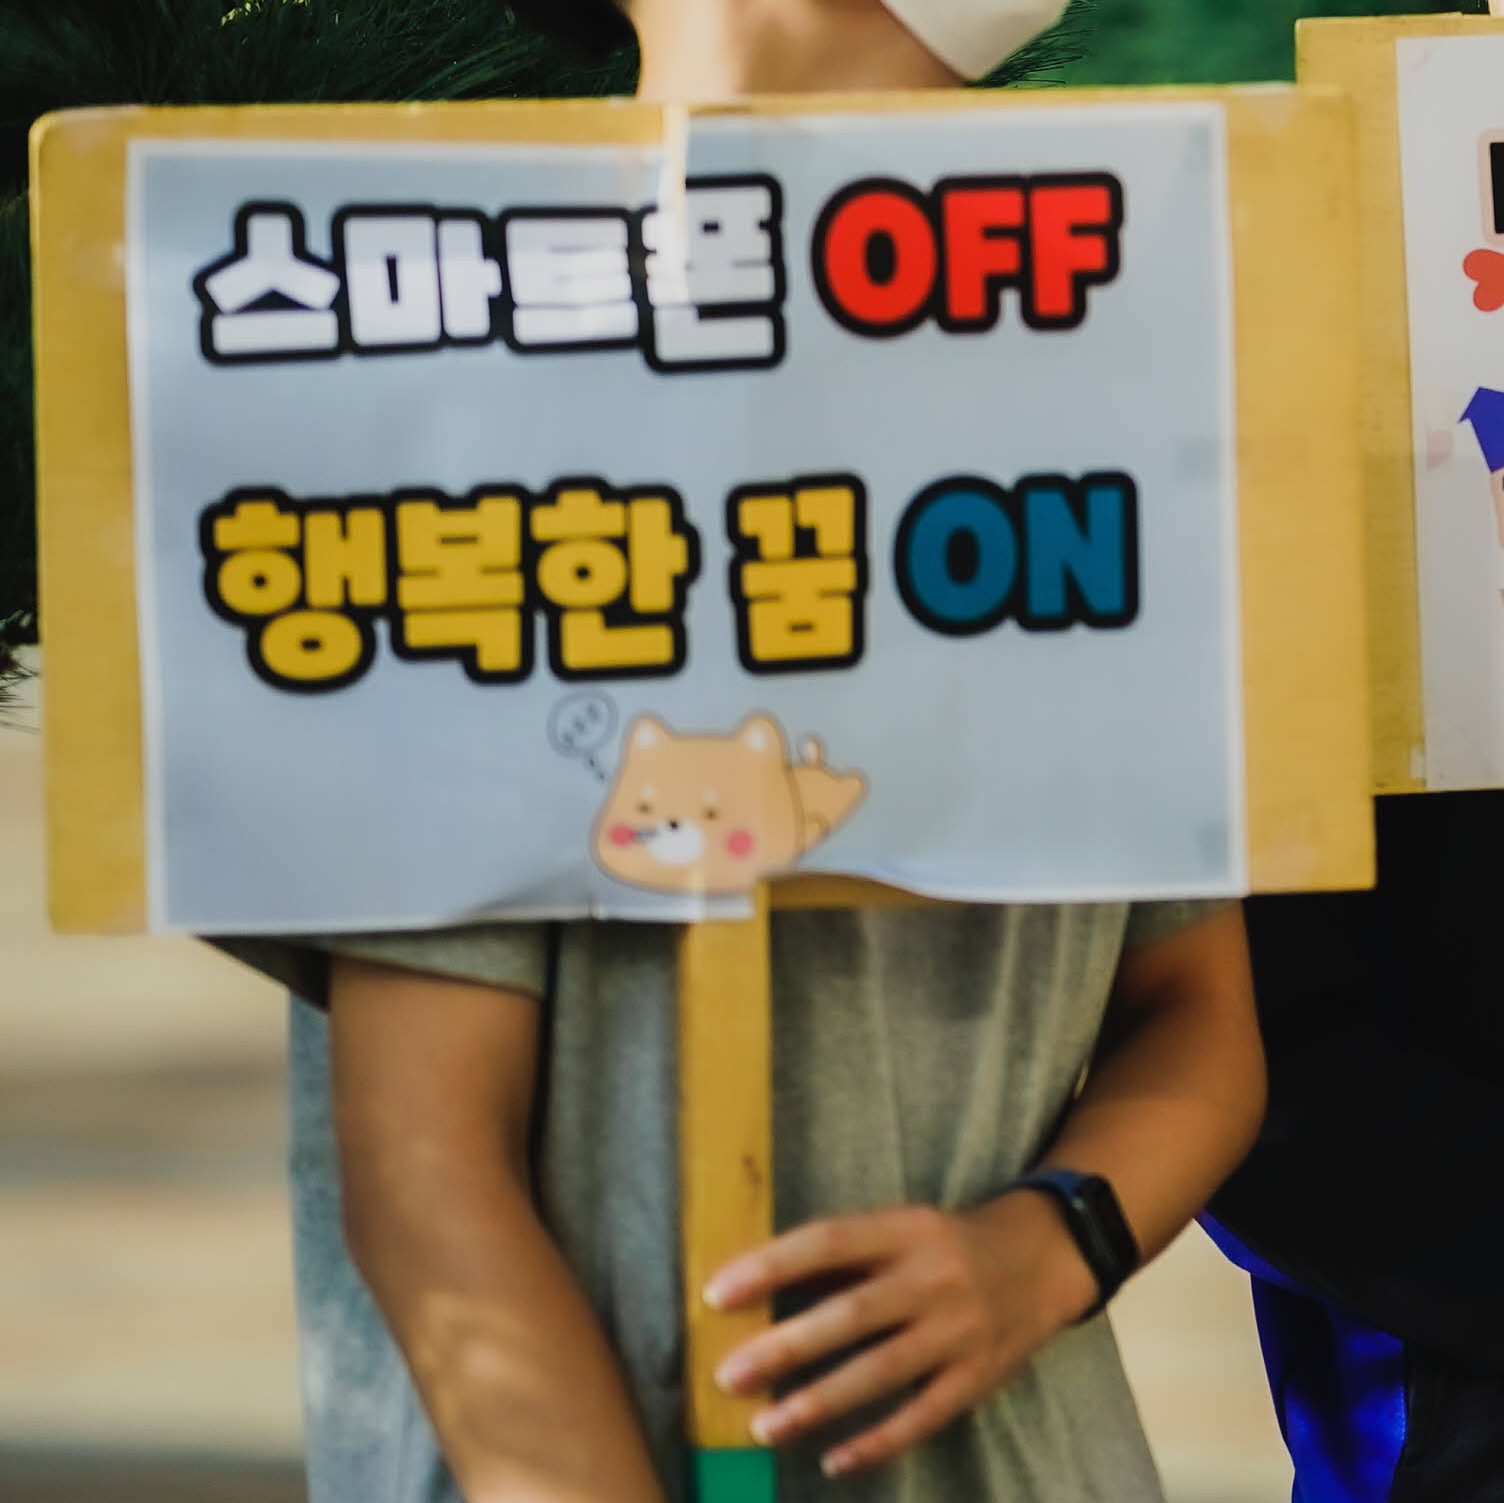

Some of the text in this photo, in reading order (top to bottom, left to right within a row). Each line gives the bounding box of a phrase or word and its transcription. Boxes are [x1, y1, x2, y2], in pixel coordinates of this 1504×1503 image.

[195, 171, 1124, 373] 스마트폰 OFF
[198, 472, 1140, 692] 행복한 꿈 ON
